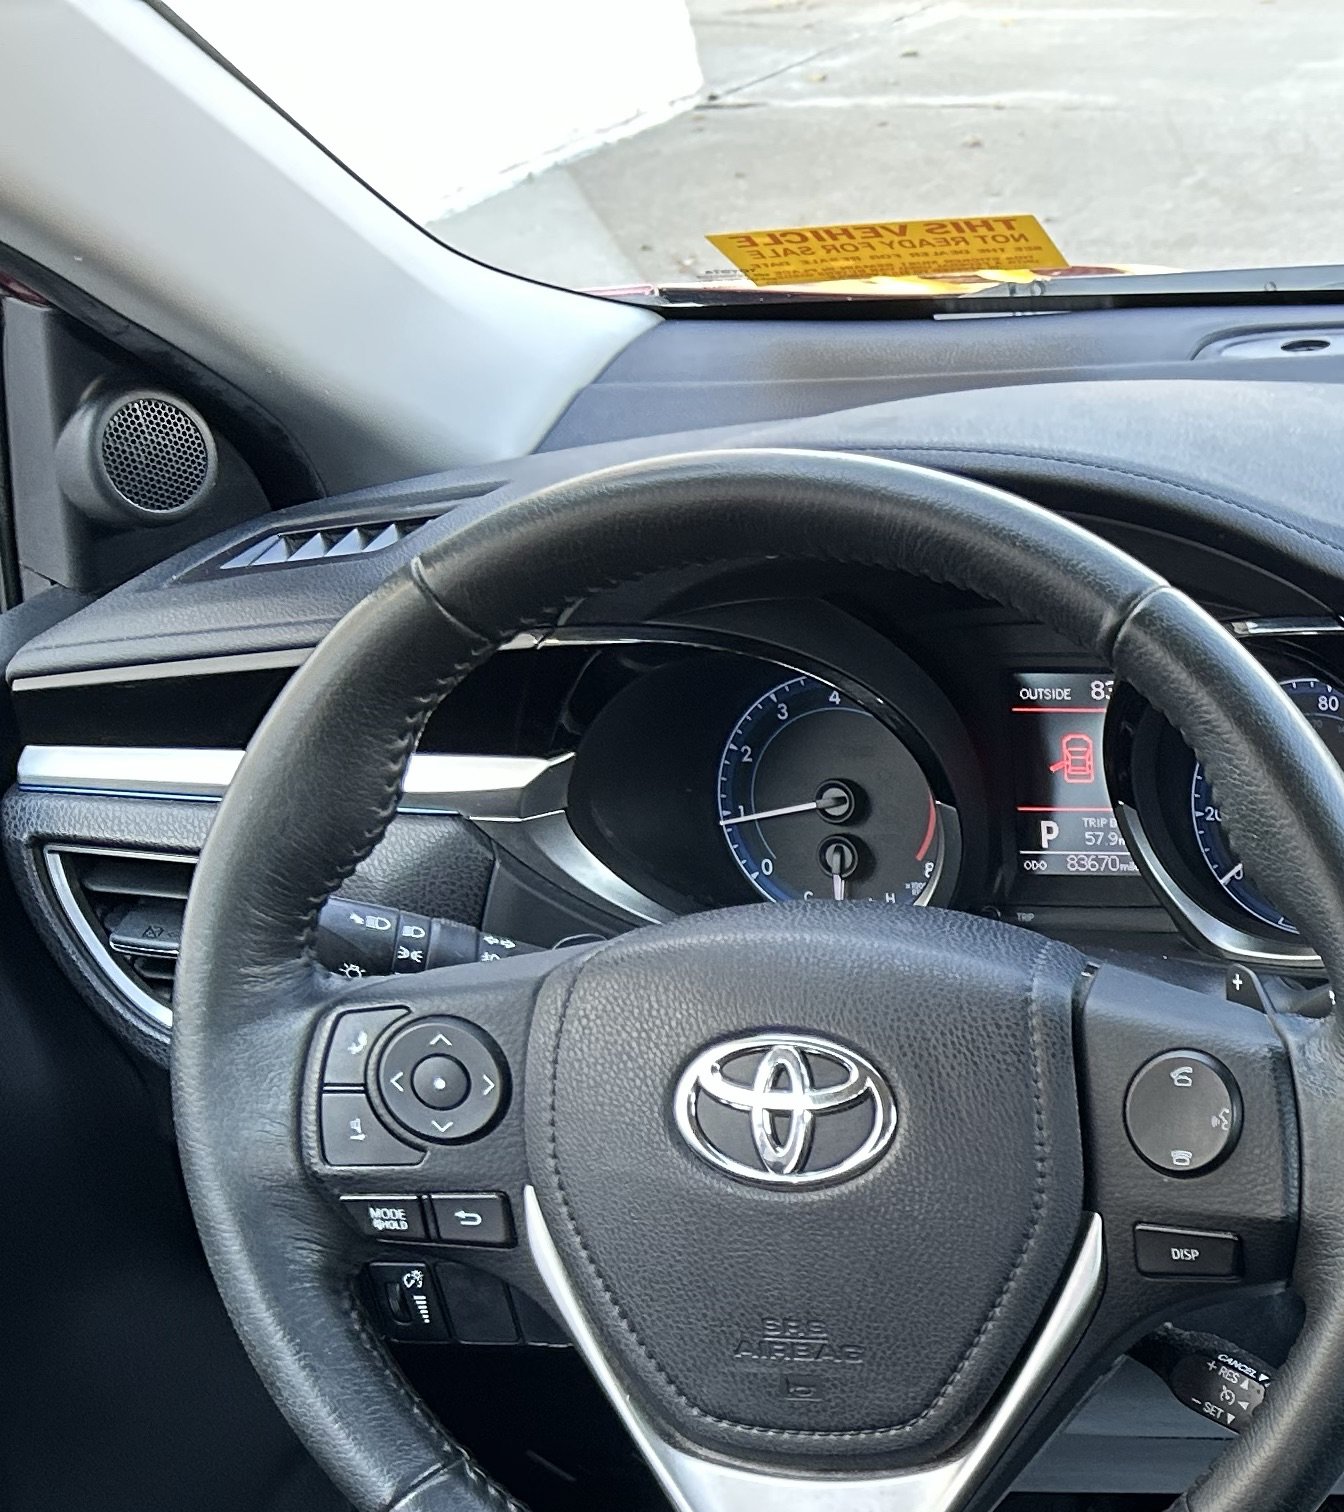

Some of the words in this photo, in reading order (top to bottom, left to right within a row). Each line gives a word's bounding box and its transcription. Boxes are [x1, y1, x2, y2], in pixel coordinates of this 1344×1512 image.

[829, 691, 840, 704] 4
[1020, 687, 1072, 700] OUTSIDE
[777, 703, 788, 720] 3
[1318, 696, 1339, 712] 80
[741, 746, 753, 762] 2
[1082, 817, 1107, 828] TRIP
[1041, 820, 1059, 848] P
[761, 859, 773, 876] 0
[1023, 860, 1048, 871] ODO
[369, 1207, 407, 1220] MODE
[1170, 1247, 1200, 1261] DISP
[1217, 1354, 1257, 1379] CANCEL
[1218, 1366, 1240, 1384] RES
[1202, 1401, 1225, 1419] SET
